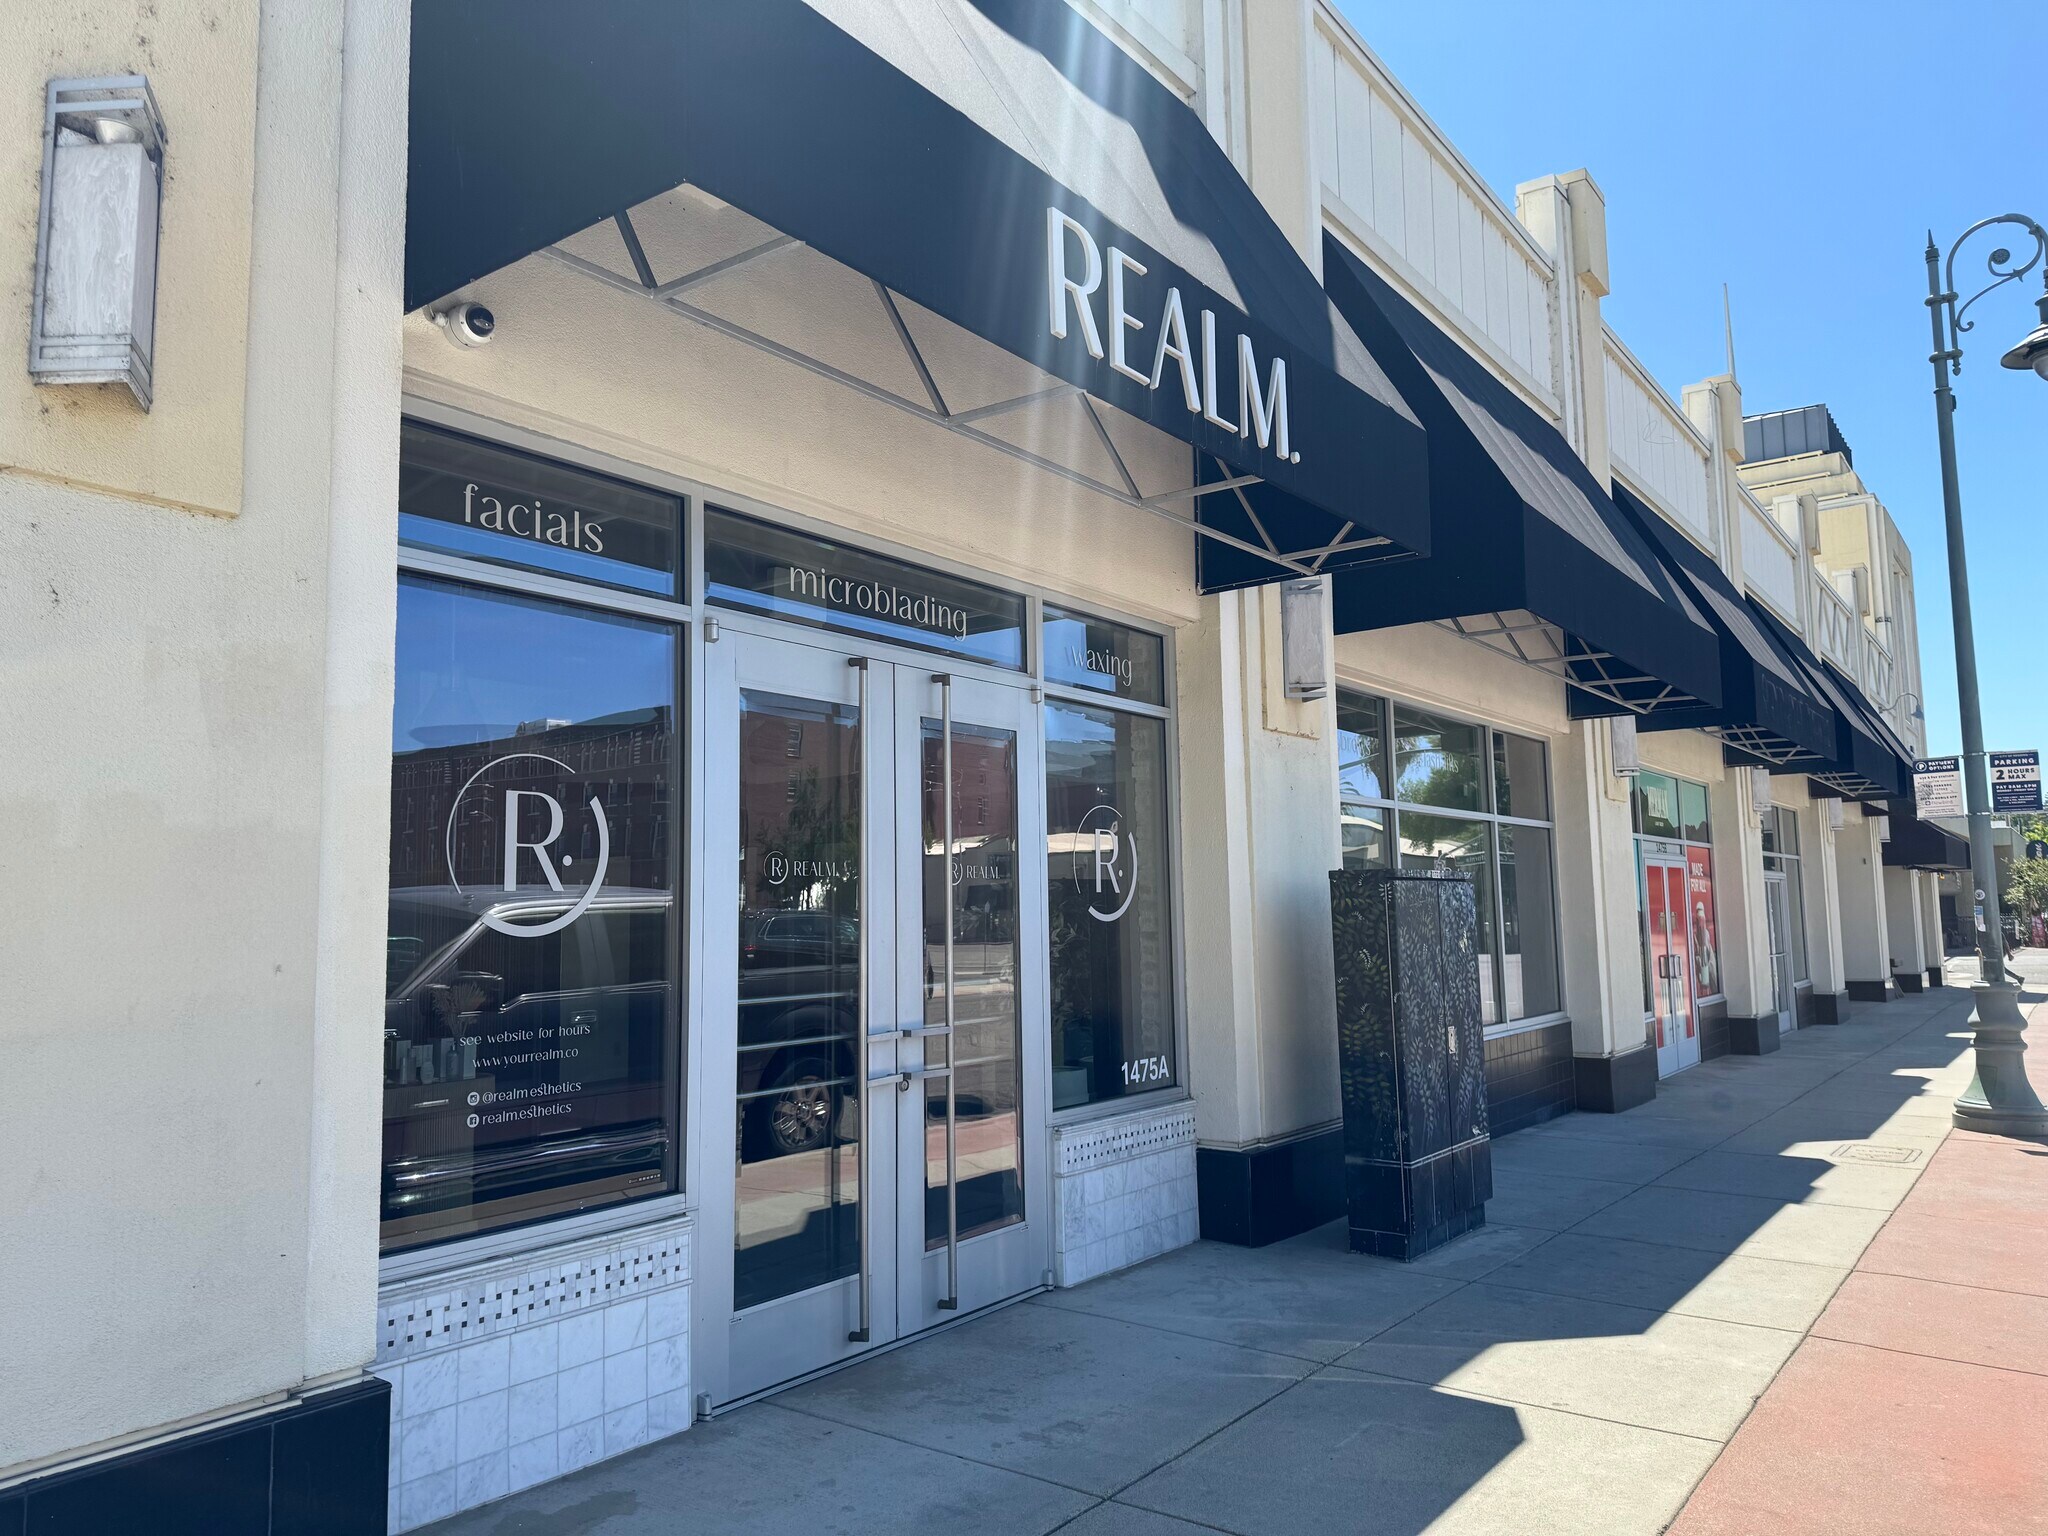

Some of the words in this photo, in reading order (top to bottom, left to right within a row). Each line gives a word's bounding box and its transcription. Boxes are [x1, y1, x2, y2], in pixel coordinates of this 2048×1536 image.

[1047, 207, 1300, 464] REALM.
[463, 483, 604, 553] facials
[790, 566, 968, 641] microblading
[1072, 646, 1132, 687] waxing
[1994, 758, 2035, 766] PARKING
[1996, 769, 2005, 780] 2
[1691, 862, 1703, 876] MADE
[1690, 878, 1698, 892] FOR
[459, 1035, 482, 1047] see
[487, 1029, 534, 1044] website
[538, 1027, 554, 1039] for
[558, 1024, 591, 1037] hours
[1121, 1055, 1170, 1085] 1475A
[482, 1103, 572, 1125] realm.esthetics
